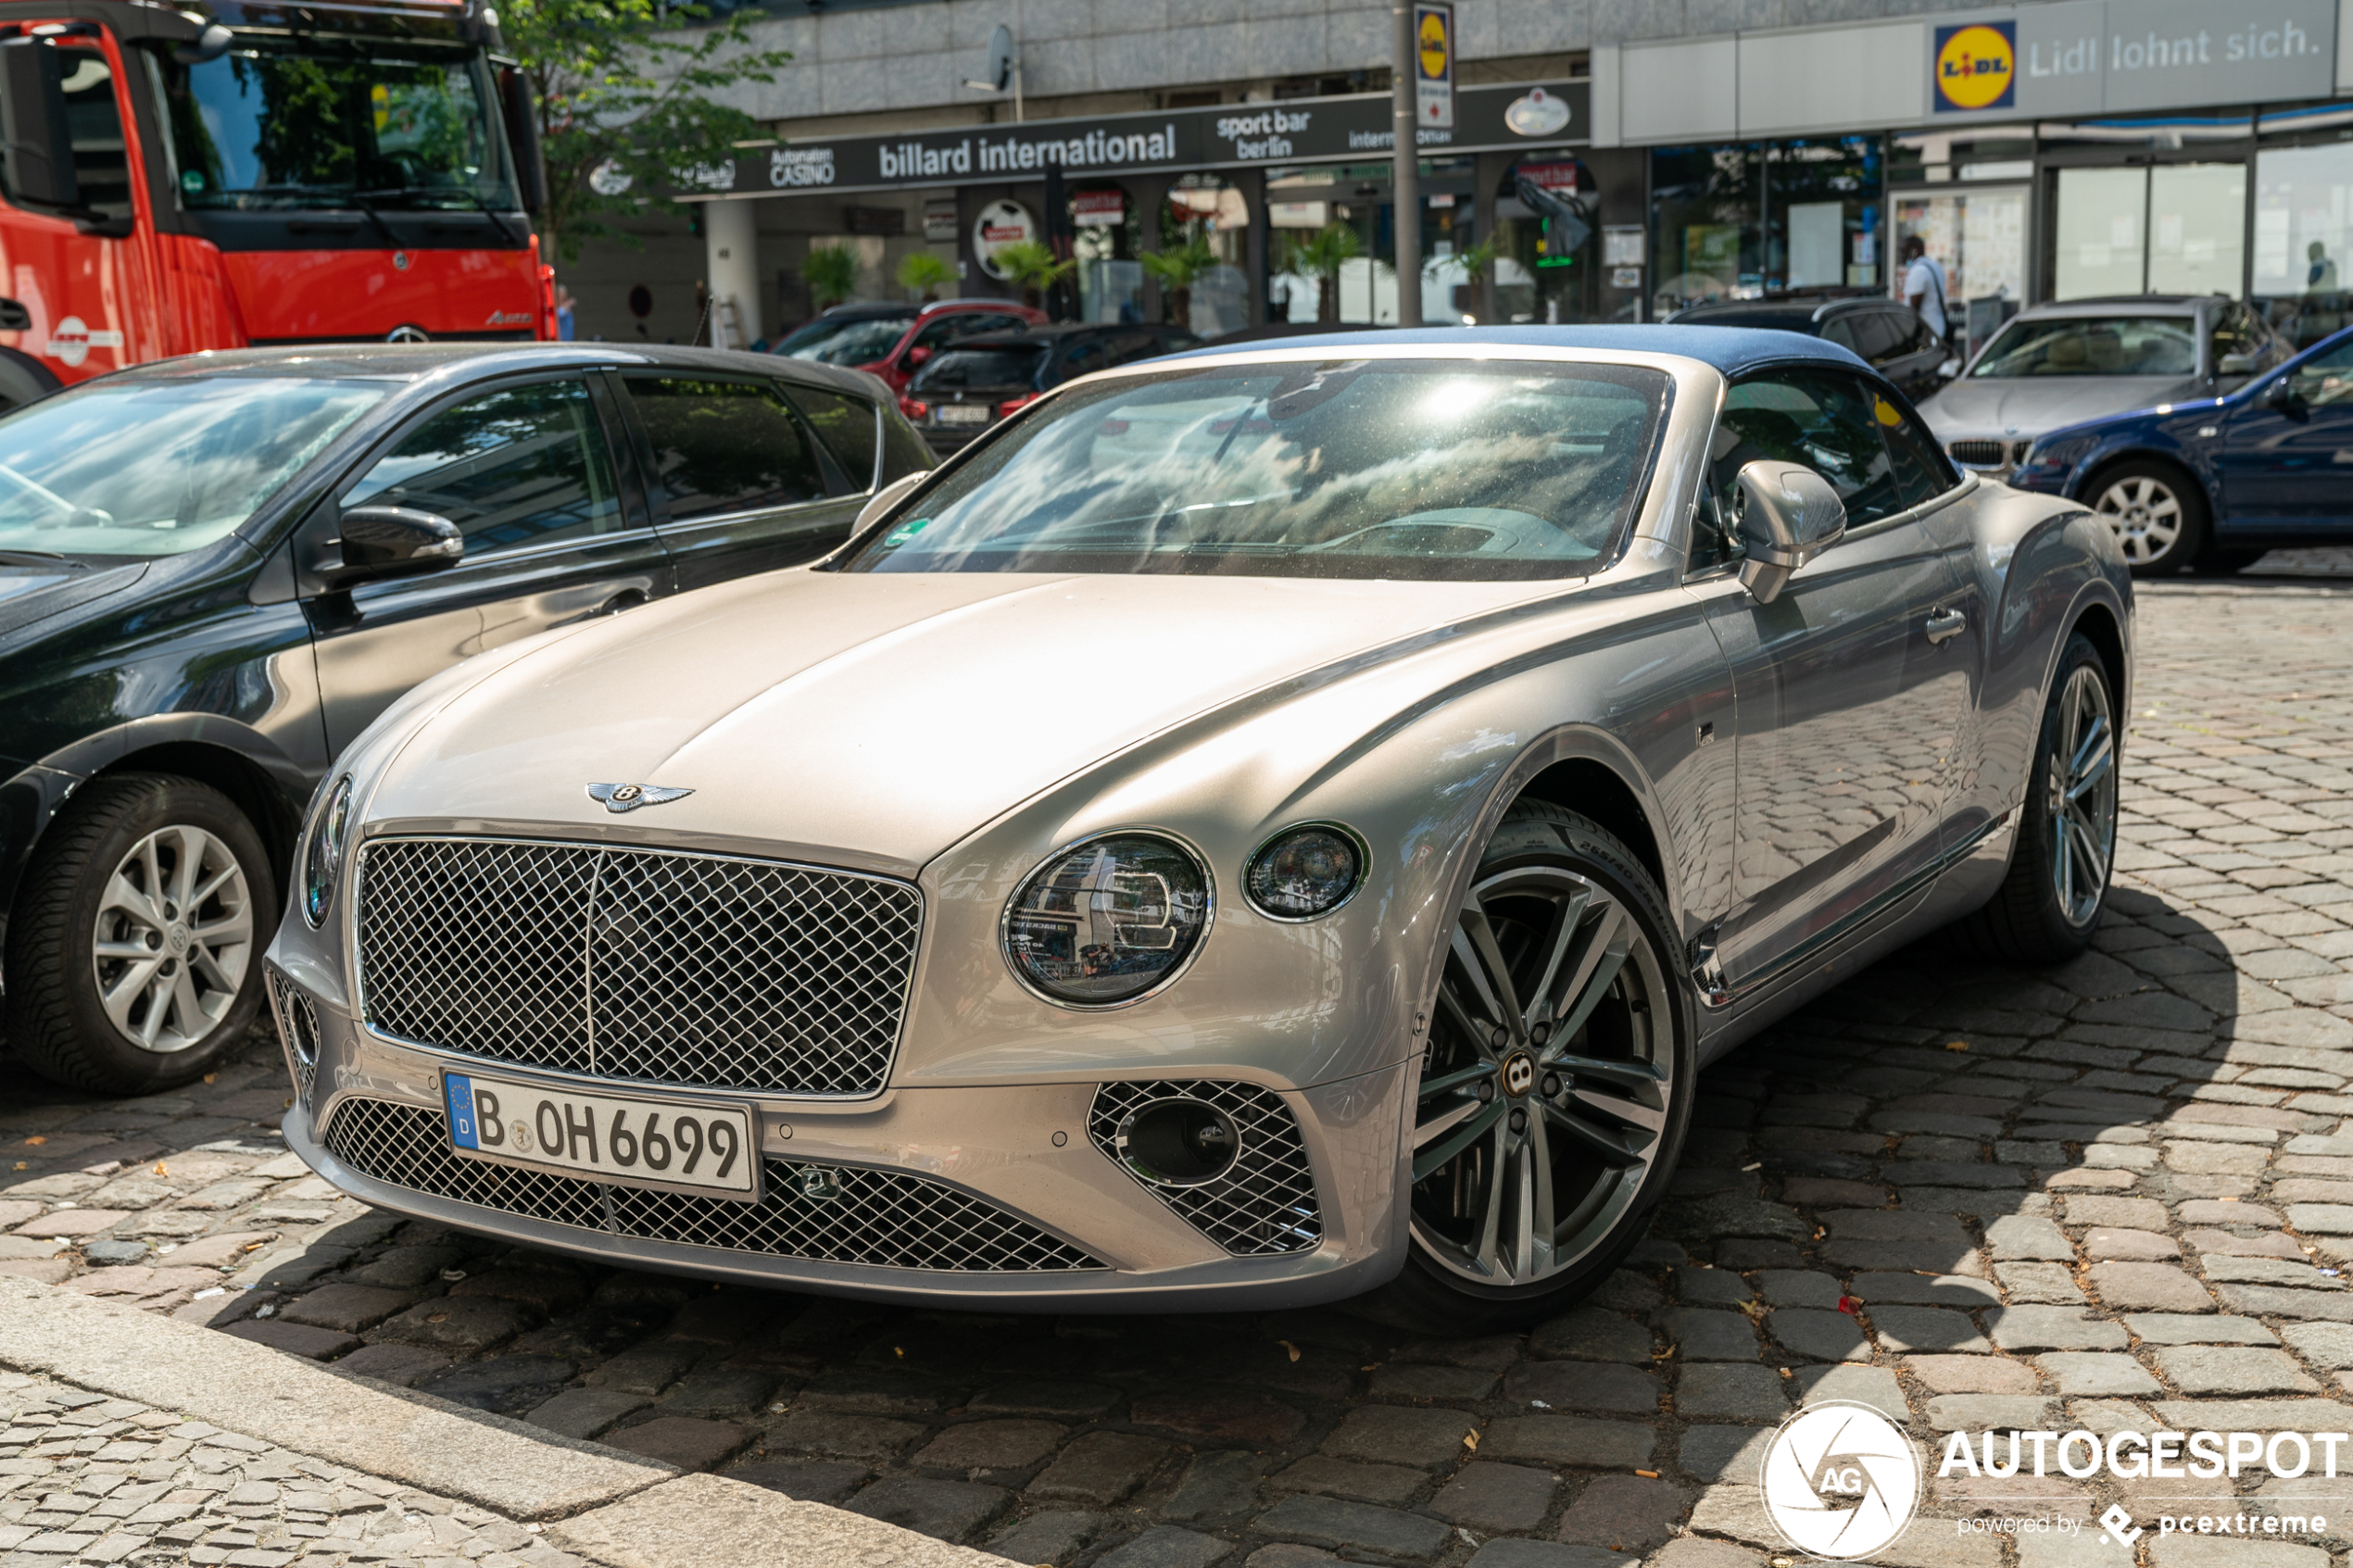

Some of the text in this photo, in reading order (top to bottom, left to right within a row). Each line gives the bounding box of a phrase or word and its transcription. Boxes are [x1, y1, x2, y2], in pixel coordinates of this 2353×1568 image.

[2029, 19, 2320, 78] Lidl lohnt sich.
[1216, 108, 1313, 143] sport bar
[1349, 129, 1453, 149] internonal
[770, 147, 835, 166] Automaten
[879, 124, 1176, 178] billard international
[1237, 134, 1293, 160] berlin
[769, 163, 836, 187] CASINO
[1579, 840, 1633, 880] 265/40
[1508, 1057, 1532, 1093] B
[459, 1117, 470, 1135] D
[474, 1088, 739, 1179] B OH 6699
